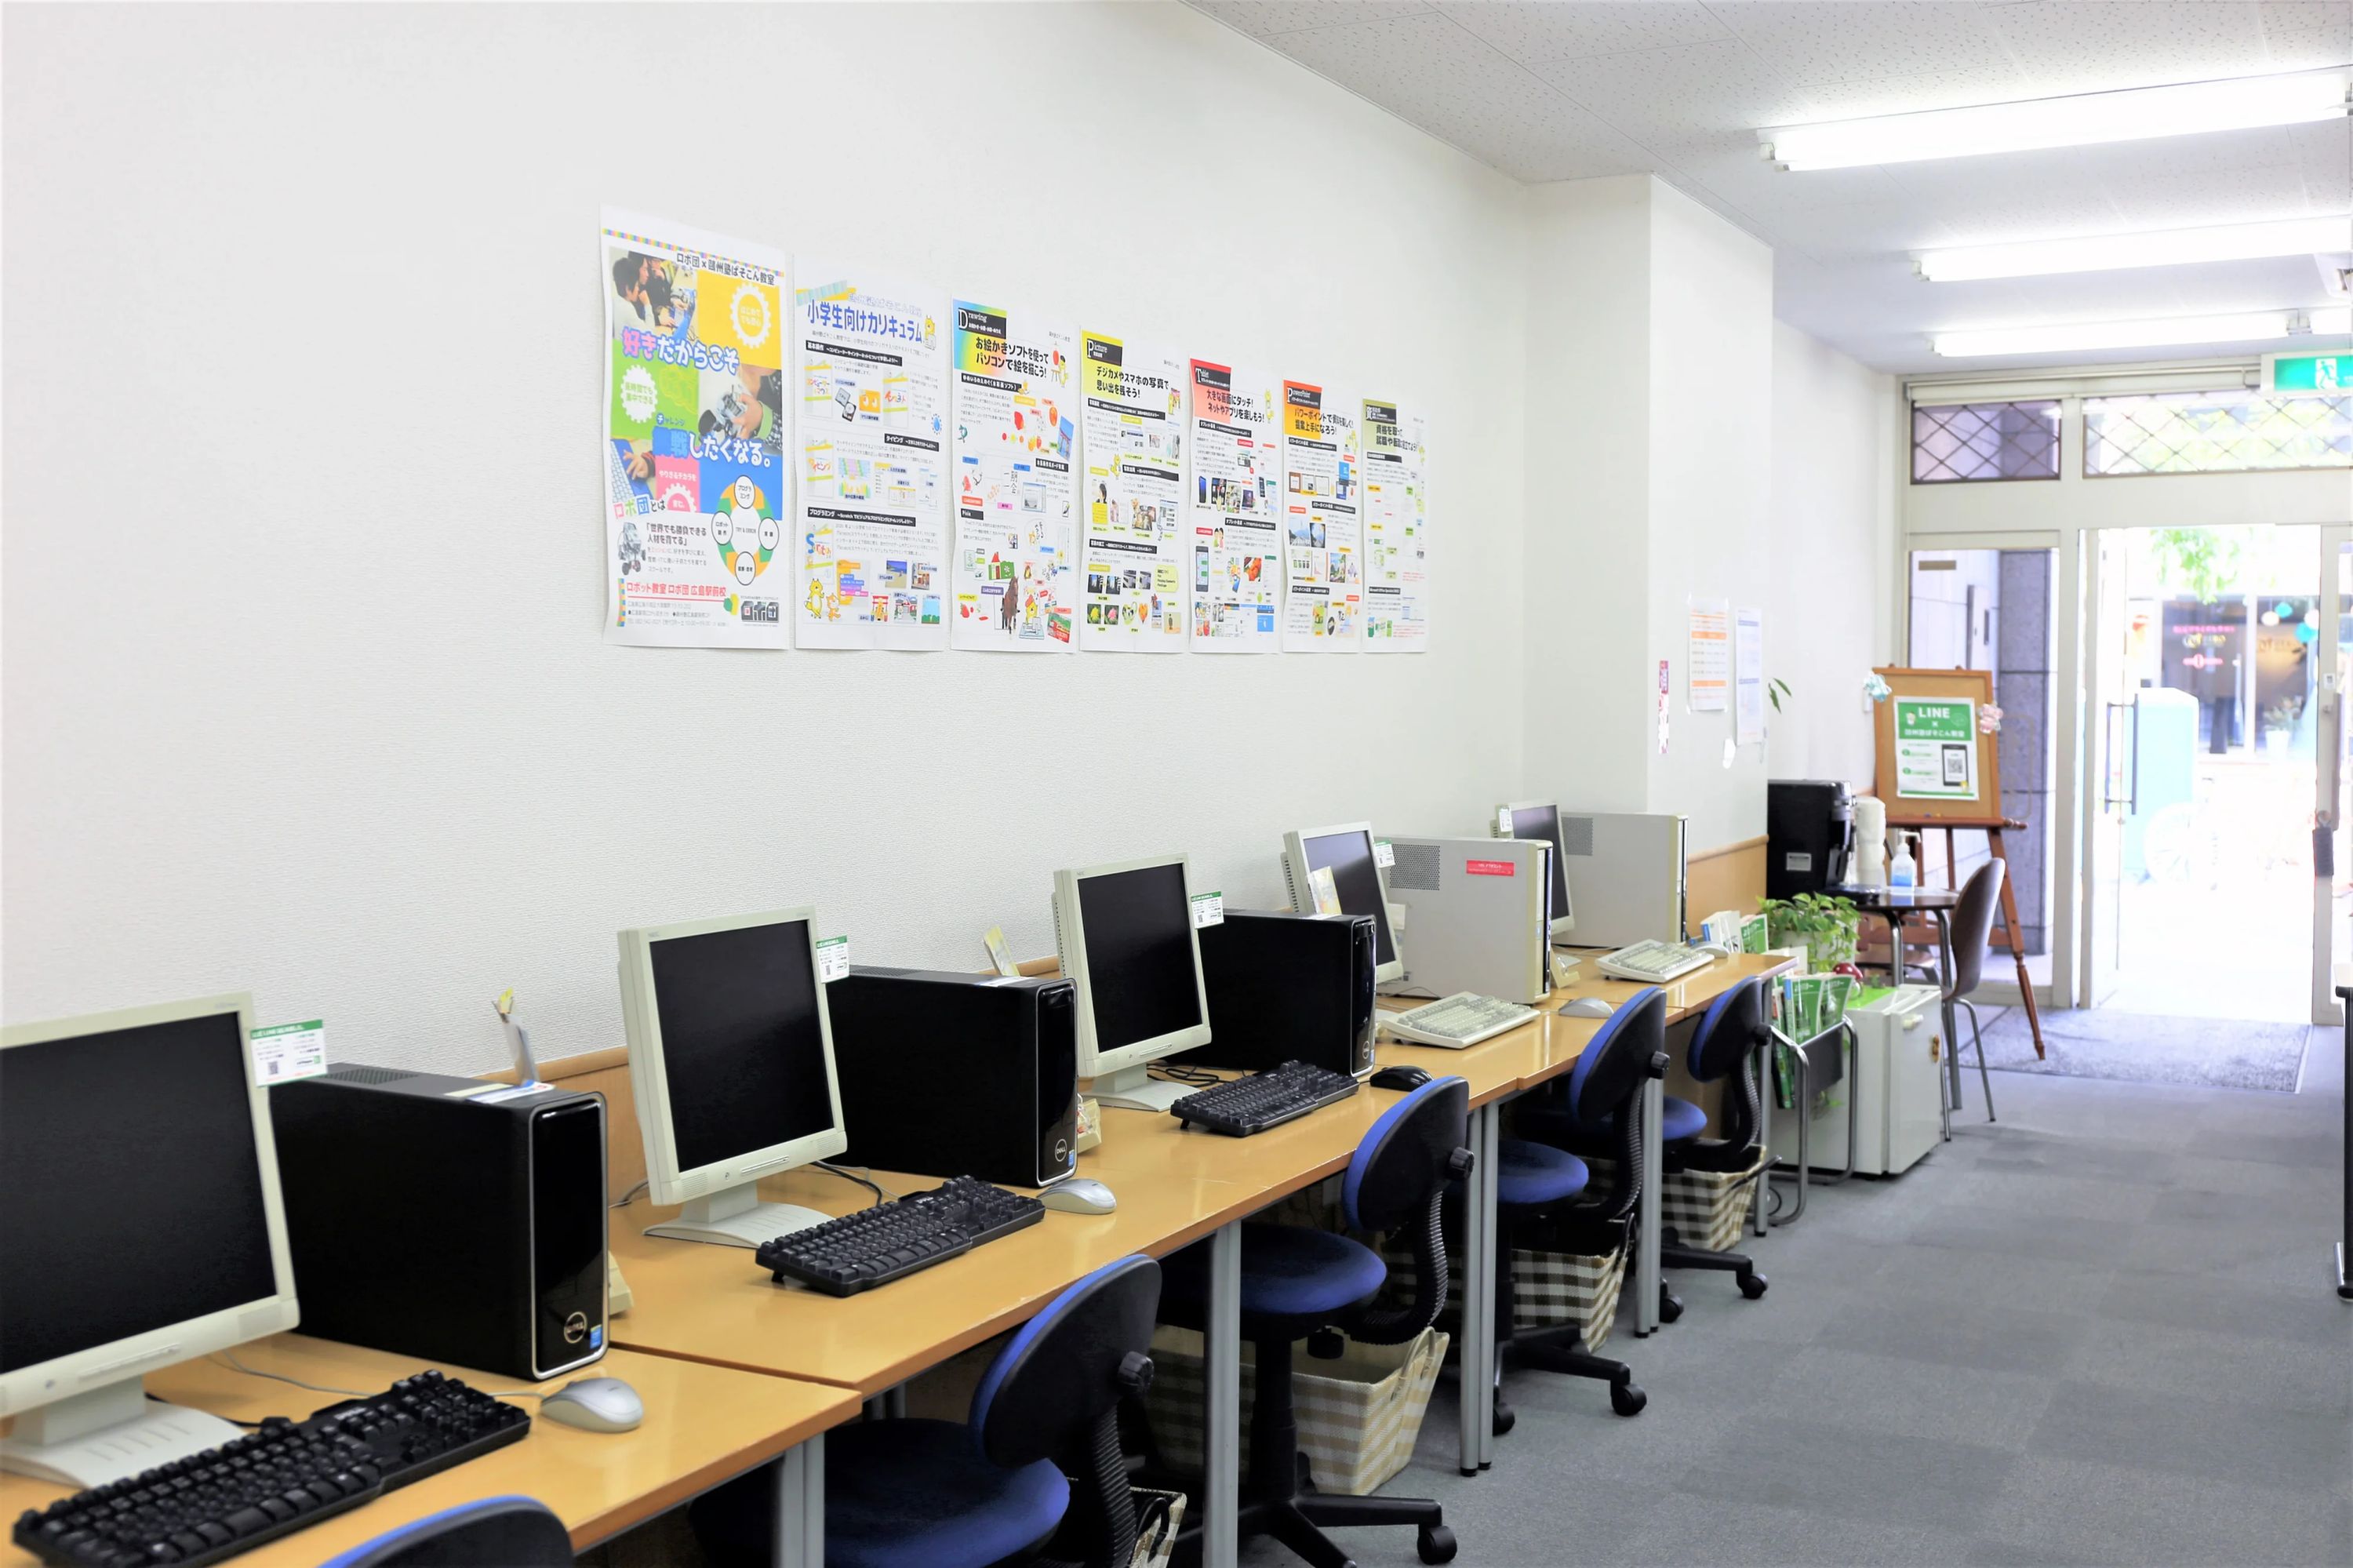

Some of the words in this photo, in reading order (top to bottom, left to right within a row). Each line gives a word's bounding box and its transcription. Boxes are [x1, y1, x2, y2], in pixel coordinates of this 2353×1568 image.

[676, 253, 700, 267] ロボ団
[807, 299, 923, 344] 小学生向けカリキュラム
[623, 326, 740, 376] 好きだからこそ
[976, 337, 1049, 365] お絵かきソフトを使って
[1096, 366, 1170, 390] デジカメやスマホの写真で
[613, 496, 666, 519] ロボ団とは
[809, 508, 835, 517] プログラミング
[627, 582, 667, 595] ロボット教室
[668, 584, 689, 596] ロボ団
[690, 584, 727, 598] 広島駅前校
[1918, 707, 1951, 719] LINE
